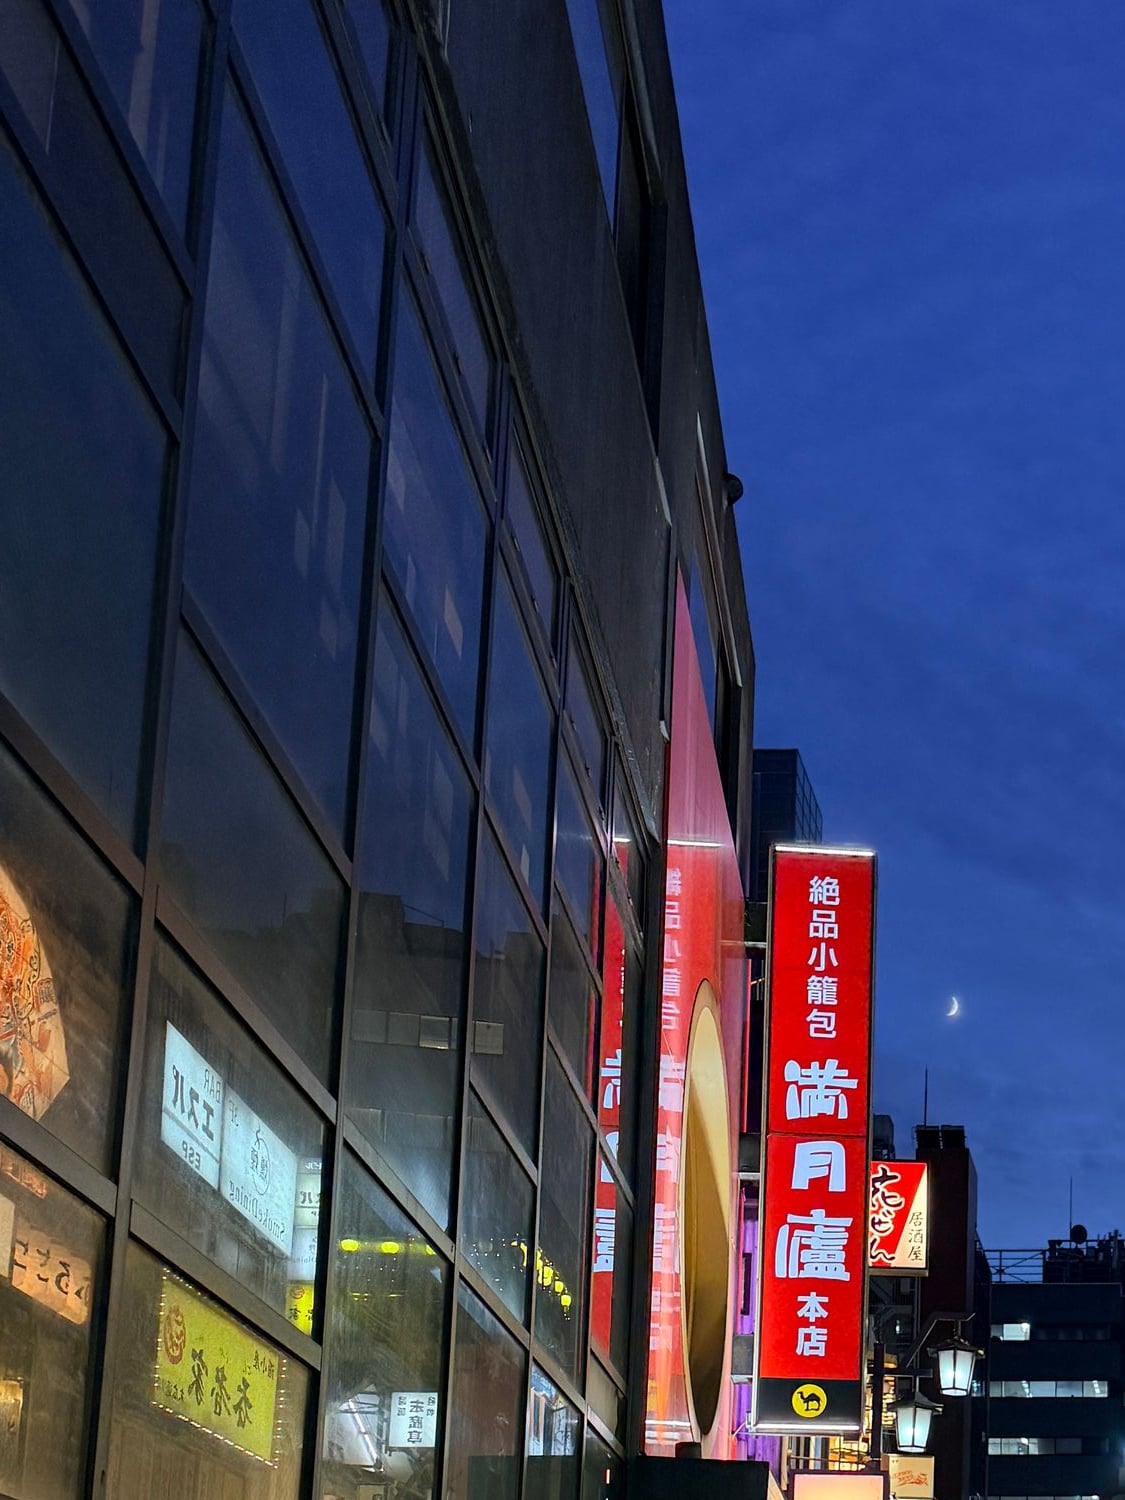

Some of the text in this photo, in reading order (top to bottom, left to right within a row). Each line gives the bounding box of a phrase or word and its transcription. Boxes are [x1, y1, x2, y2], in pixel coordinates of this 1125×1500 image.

[806, 876, 841, 1040] 絶品小籠包
[908, 1211, 924, 1262] 居酒屋
[796, 1292, 829, 1358] 本店
